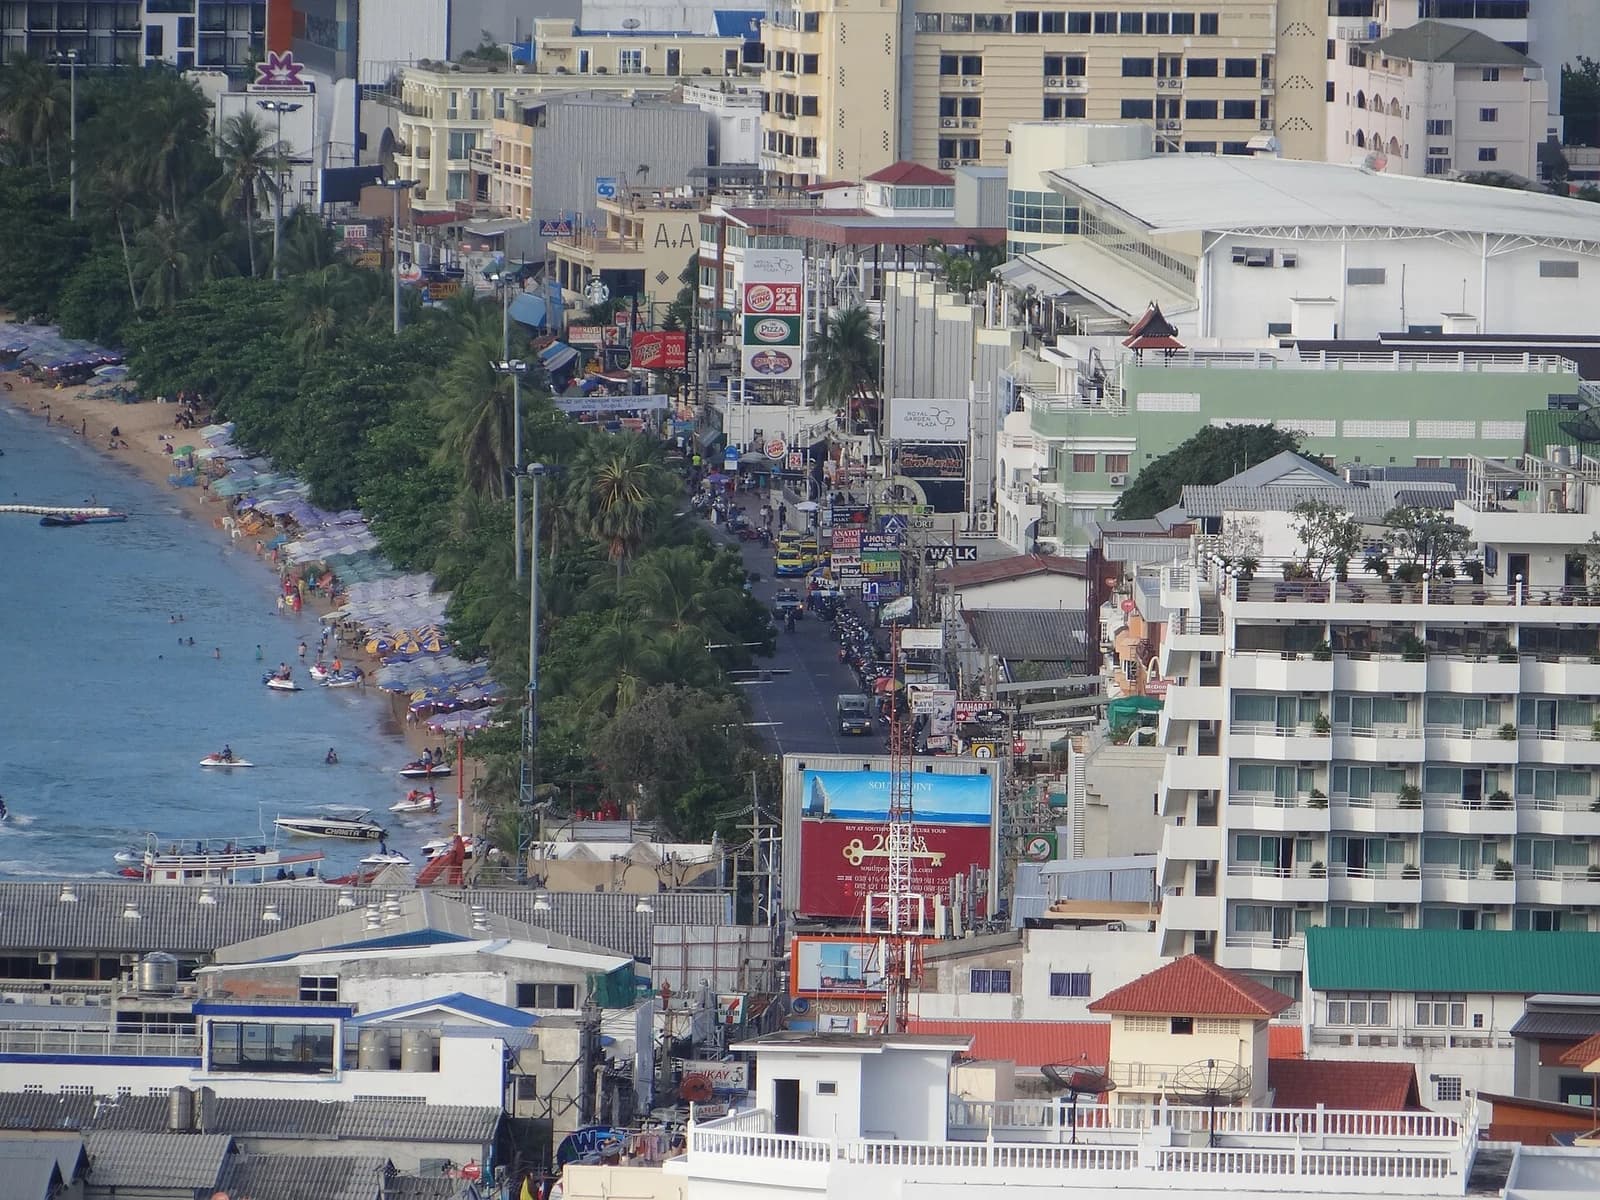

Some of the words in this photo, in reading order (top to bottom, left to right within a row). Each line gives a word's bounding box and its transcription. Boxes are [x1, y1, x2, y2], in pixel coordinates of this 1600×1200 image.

[751, 294, 771, 305] KING
[775, 293, 797, 306] 24
[761, 324, 784, 333] PIZZA
